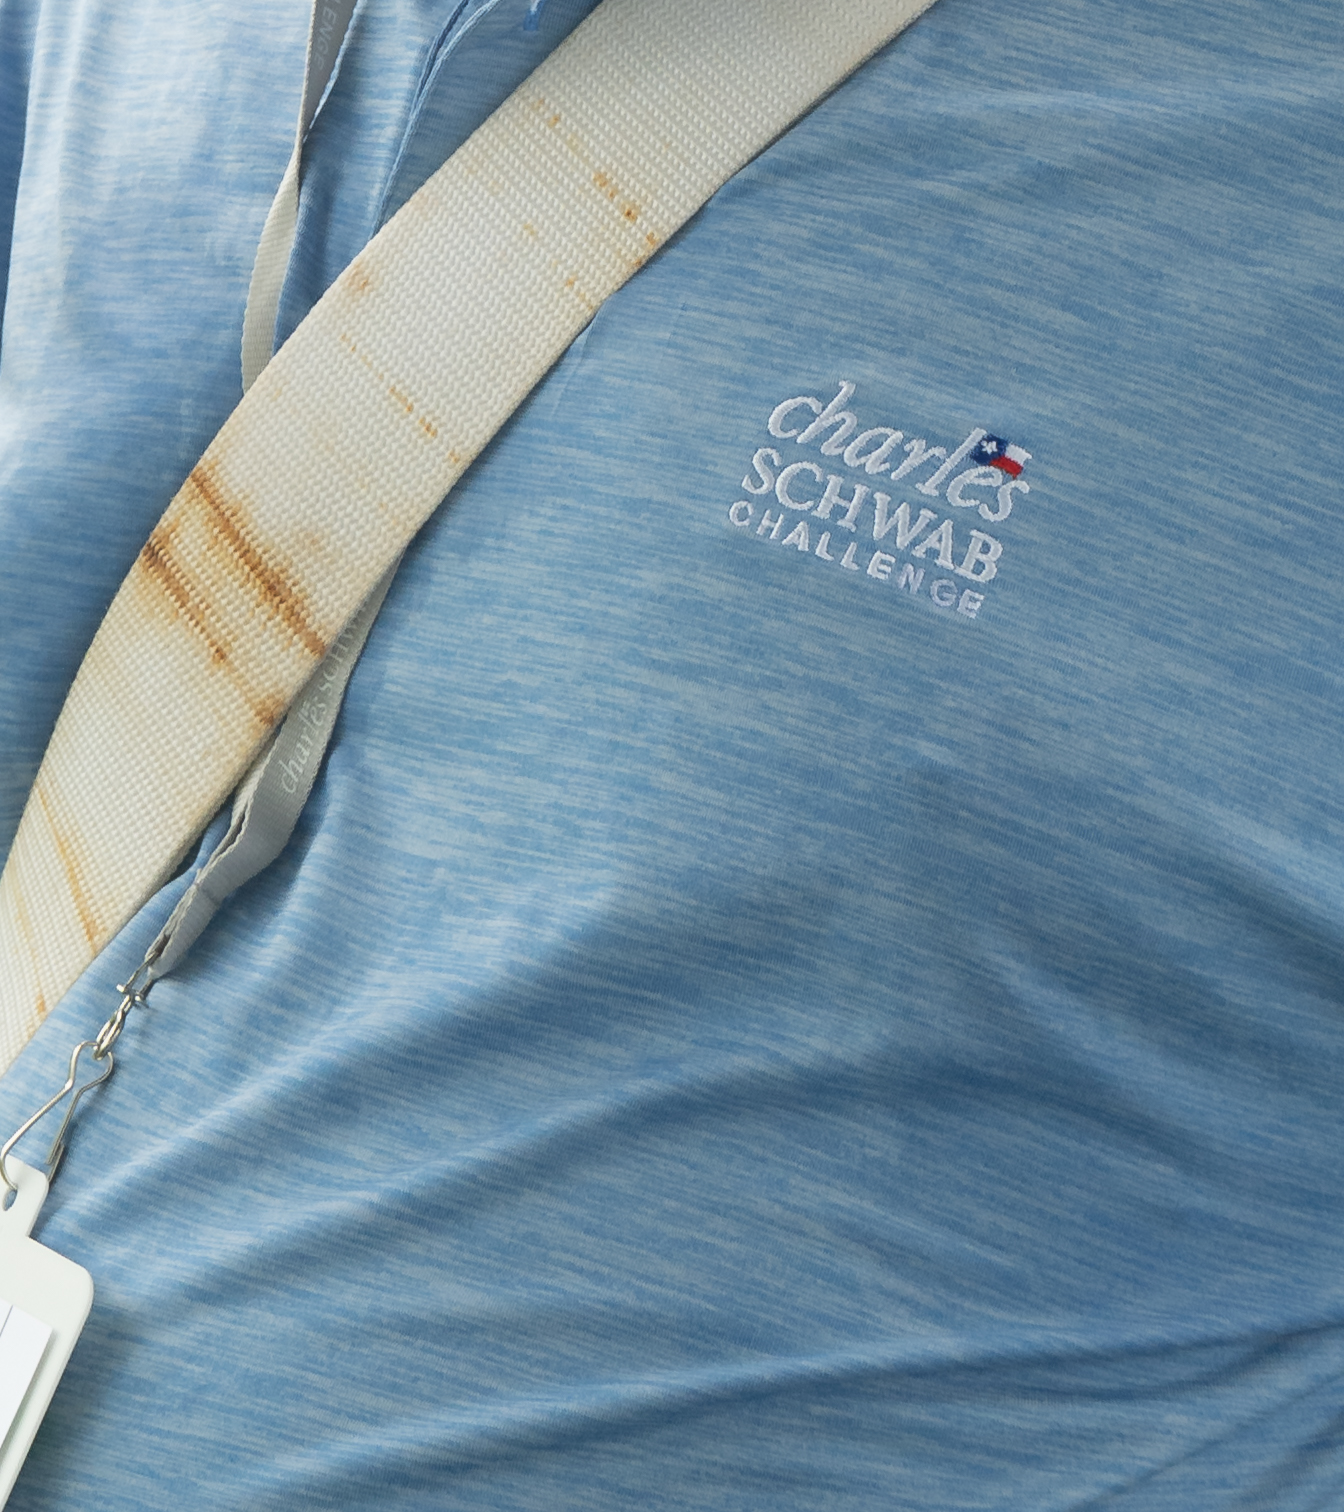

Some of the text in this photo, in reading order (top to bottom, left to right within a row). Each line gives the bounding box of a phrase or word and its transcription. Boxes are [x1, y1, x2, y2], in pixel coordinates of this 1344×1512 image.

[741, 447, 1004, 583] SCHWAB
[767, 380, 1032, 523] charles
[728, 500, 985, 619] CHALLENGE
[280, 699, 328, 794] charles
